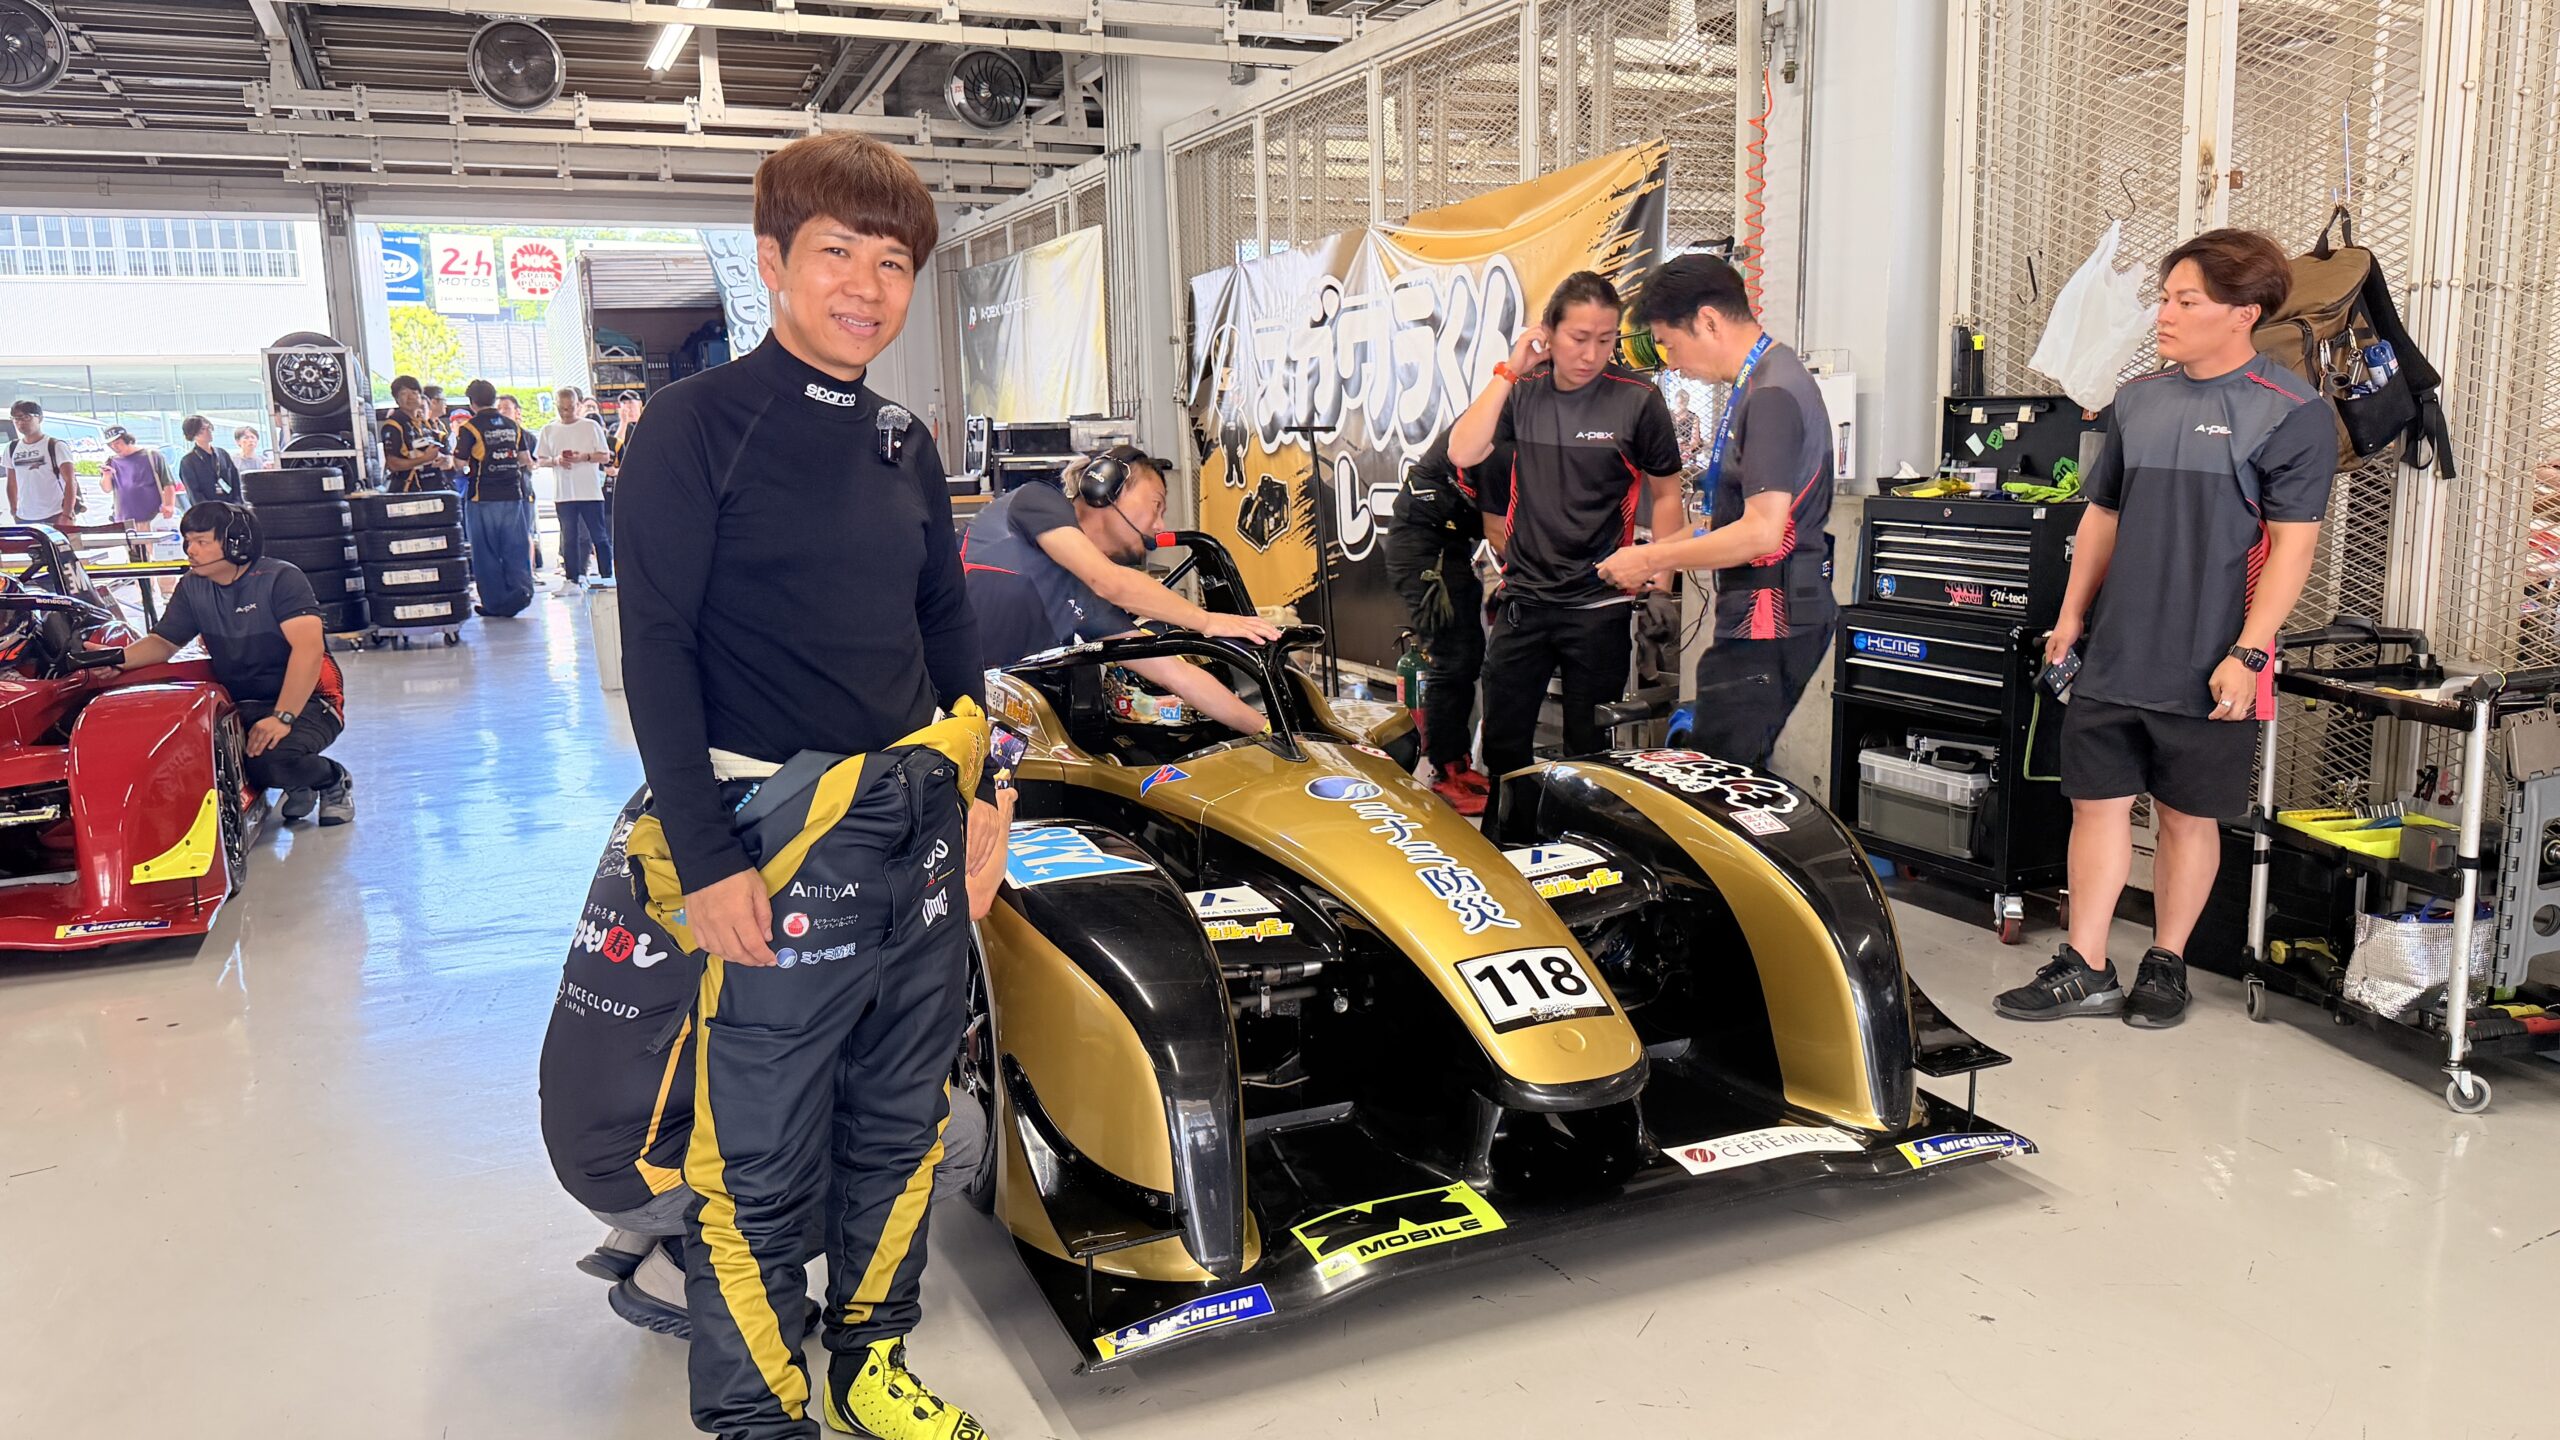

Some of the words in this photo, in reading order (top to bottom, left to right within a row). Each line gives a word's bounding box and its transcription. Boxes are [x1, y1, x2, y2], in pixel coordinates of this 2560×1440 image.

[437, 277, 490, 288] MOTOS
[805, 383, 857, 407] sparco
[1008, 827, 1106, 868] SKY
[1350, 802, 1522, 935] ミナミ防災
[1523, 867, 1552, 876] AIWA
[1554, 857, 1596, 870] GROUP
[1224, 906, 1270, 915] GROUP
[88, 920, 161, 933] MICHELIN
[1474, 956, 1588, 1008] 118
[564, 999, 587, 1017] JAPAN
[567, 982, 640, 1019] RICECLOUD
[1721, 1133, 1847, 1158] CEREMUSE
[1939, 1134, 2013, 1153] MICHELIN
[1356, 1217, 1484, 1257] MOBILE
[1147, 1295, 1255, 1339] MICHELIN
